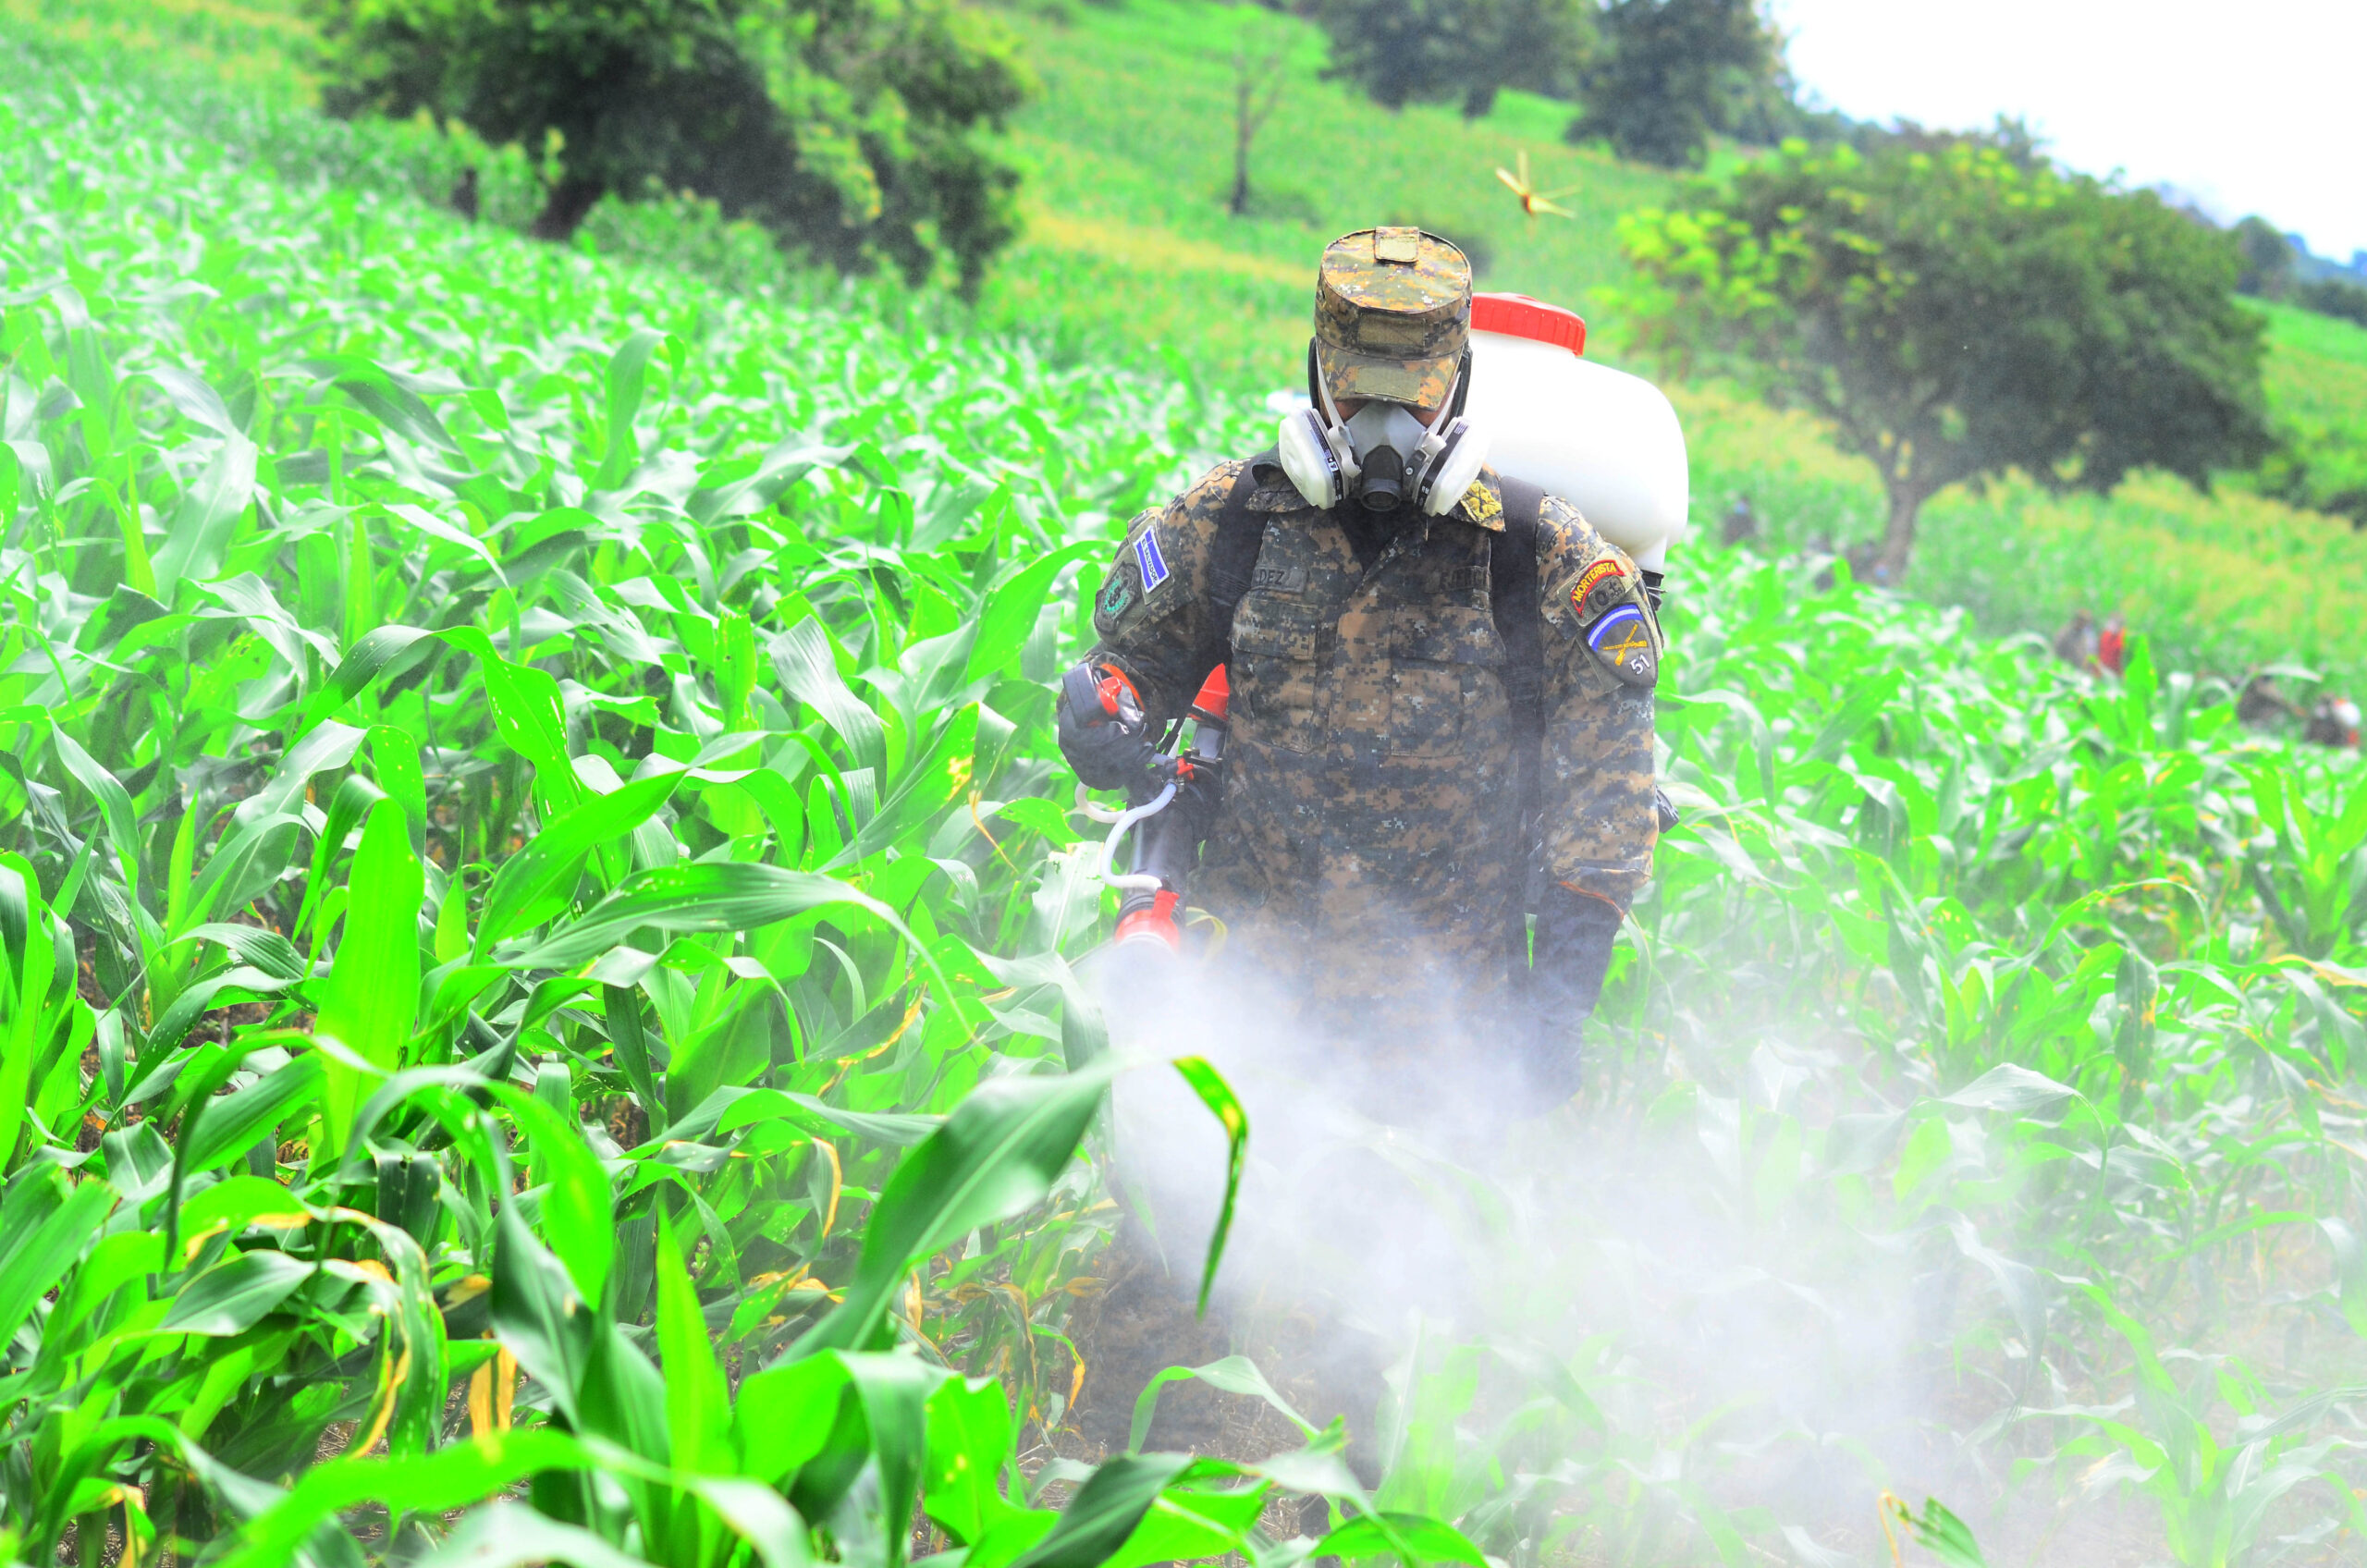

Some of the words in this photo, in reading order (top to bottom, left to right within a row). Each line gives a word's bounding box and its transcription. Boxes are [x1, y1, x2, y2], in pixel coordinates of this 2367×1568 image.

[1145, 547, 1159, 582] SALVADOR
[1573, 562, 1617, 602] MORTERISTA
[1630, 655, 1650, 675] 51
